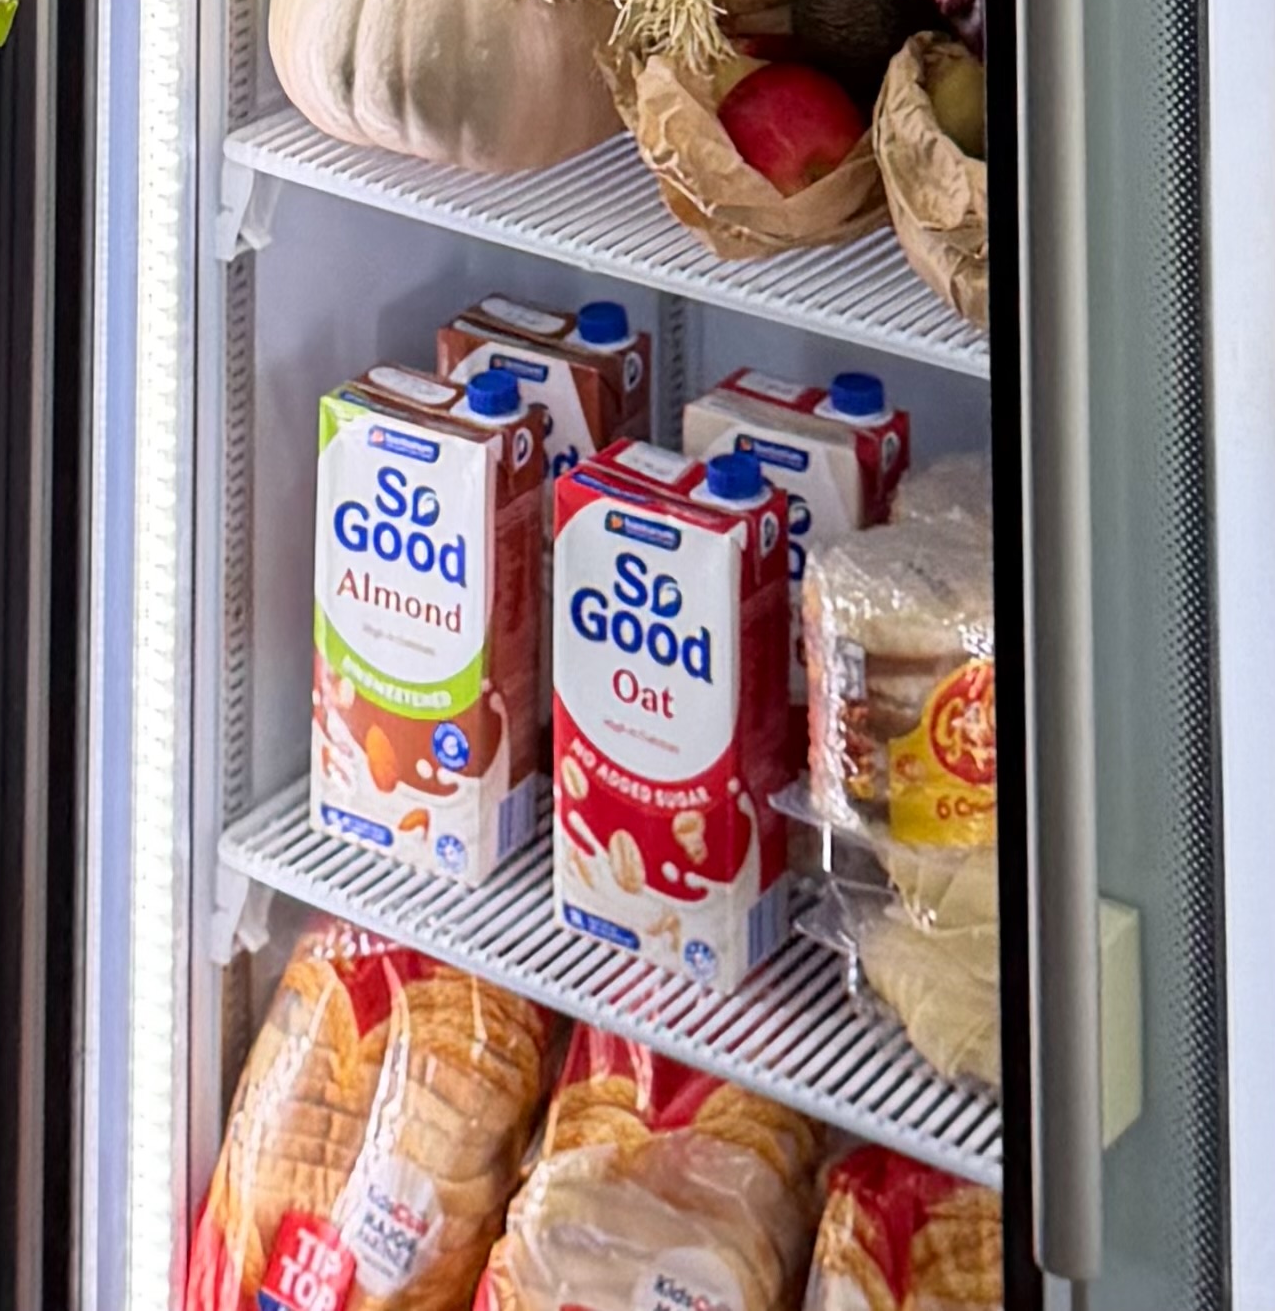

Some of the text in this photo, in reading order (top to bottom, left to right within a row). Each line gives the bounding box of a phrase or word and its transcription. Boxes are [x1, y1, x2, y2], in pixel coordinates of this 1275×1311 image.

[375, 466, 441, 527] So
[333, 500, 468, 588] Good
[336, 567, 462, 633] Almond
[614, 551, 683, 618] So
[570, 586, 713, 685] Good
[612, 669, 675, 720] Oat
[570, 737, 712, 809] NO ADDED SUGAR
[279, 1254, 337, 1311] TOP
[297, 1227, 342, 1278] TIP
